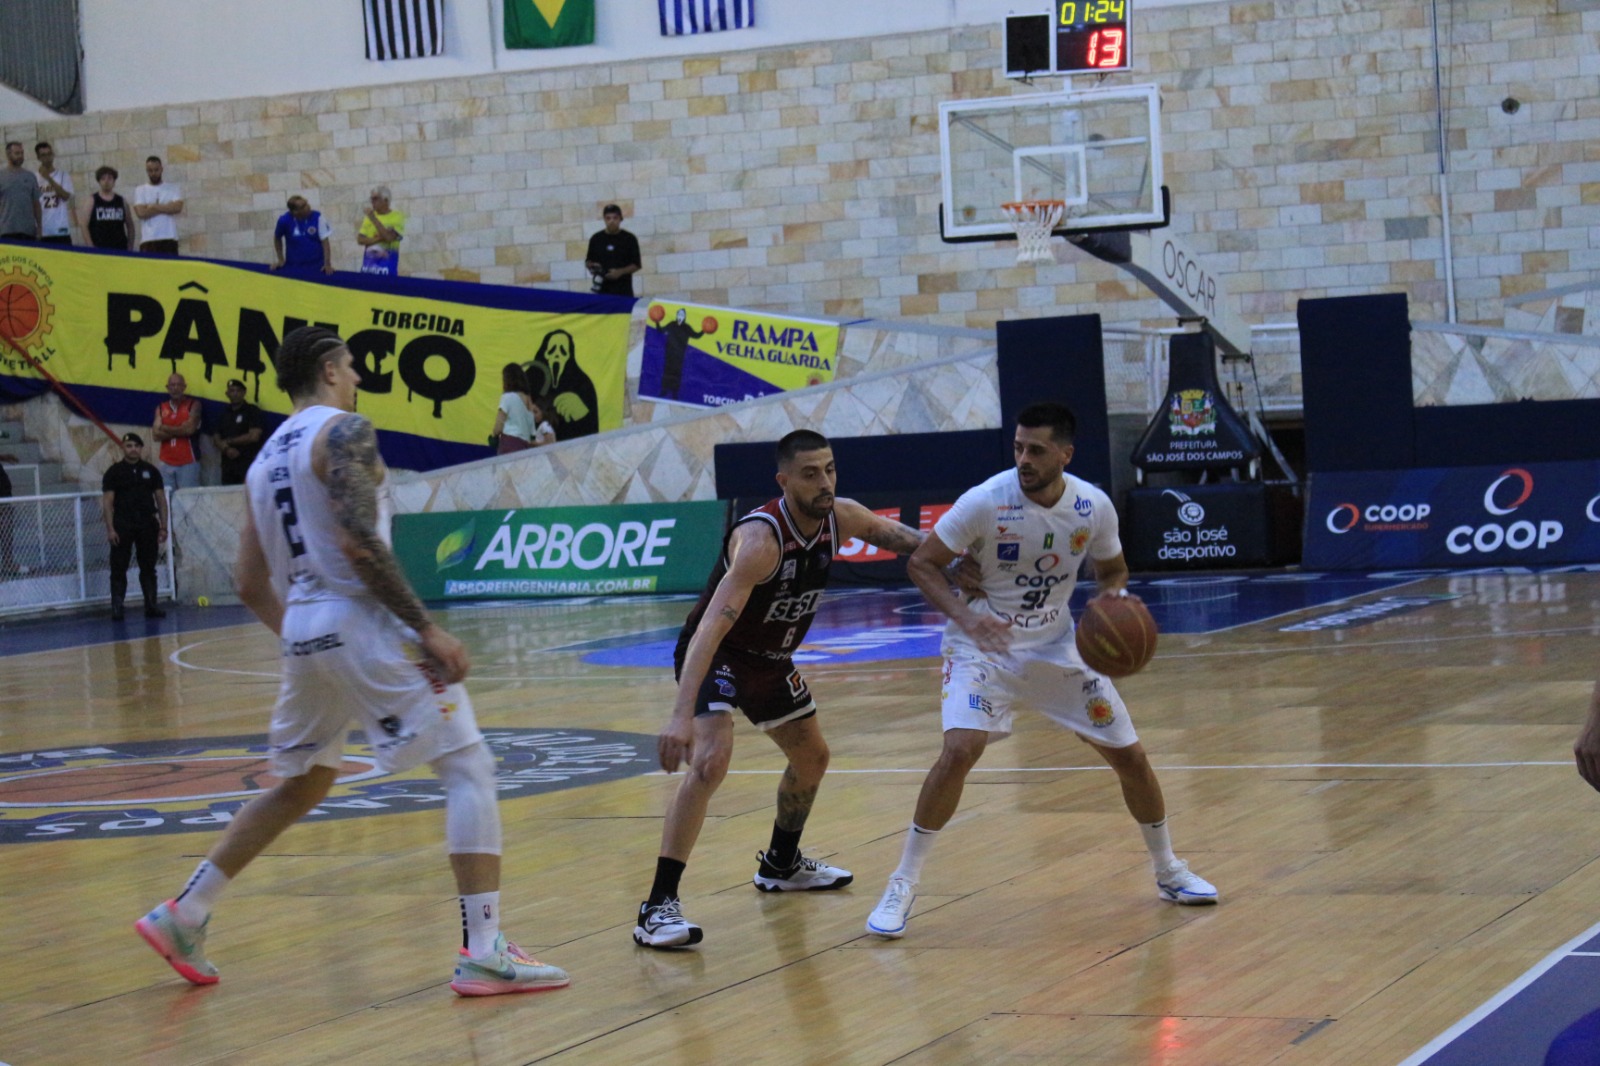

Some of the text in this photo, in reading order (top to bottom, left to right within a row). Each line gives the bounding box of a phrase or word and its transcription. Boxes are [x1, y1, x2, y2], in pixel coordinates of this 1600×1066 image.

[1060, 0, 1124, 25] 01:24
[1087, 28, 1123, 67] 13
[1163, 240, 1216, 318] OSCAR
[371, 308, 465, 336] TORCIDA
[732, 319, 819, 352] RAMPA
[104, 280, 476, 412] PÂNCO
[716, 341, 831, 371] VELHA GUARDA
[1146, 450, 1243, 463] SÃO JOSÉ DOS CAMPOS
[1170, 440, 1218, 450] PREFEITURA
[1364, 503, 1431, 522] COOP
[474, 510, 676, 571] ÁRBORE
[1163, 525, 1228, 544] são josé
[1445, 520, 1564, 555] COOP
[1157, 542, 1237, 562] desportivo
[448, 578, 651, 595] ARBOREENGENHARIA.COM.BR
[770, 590, 820, 621] SESI
[782, 626, 797, 648] 6
[26, 794, 448, 837] CAPOS
